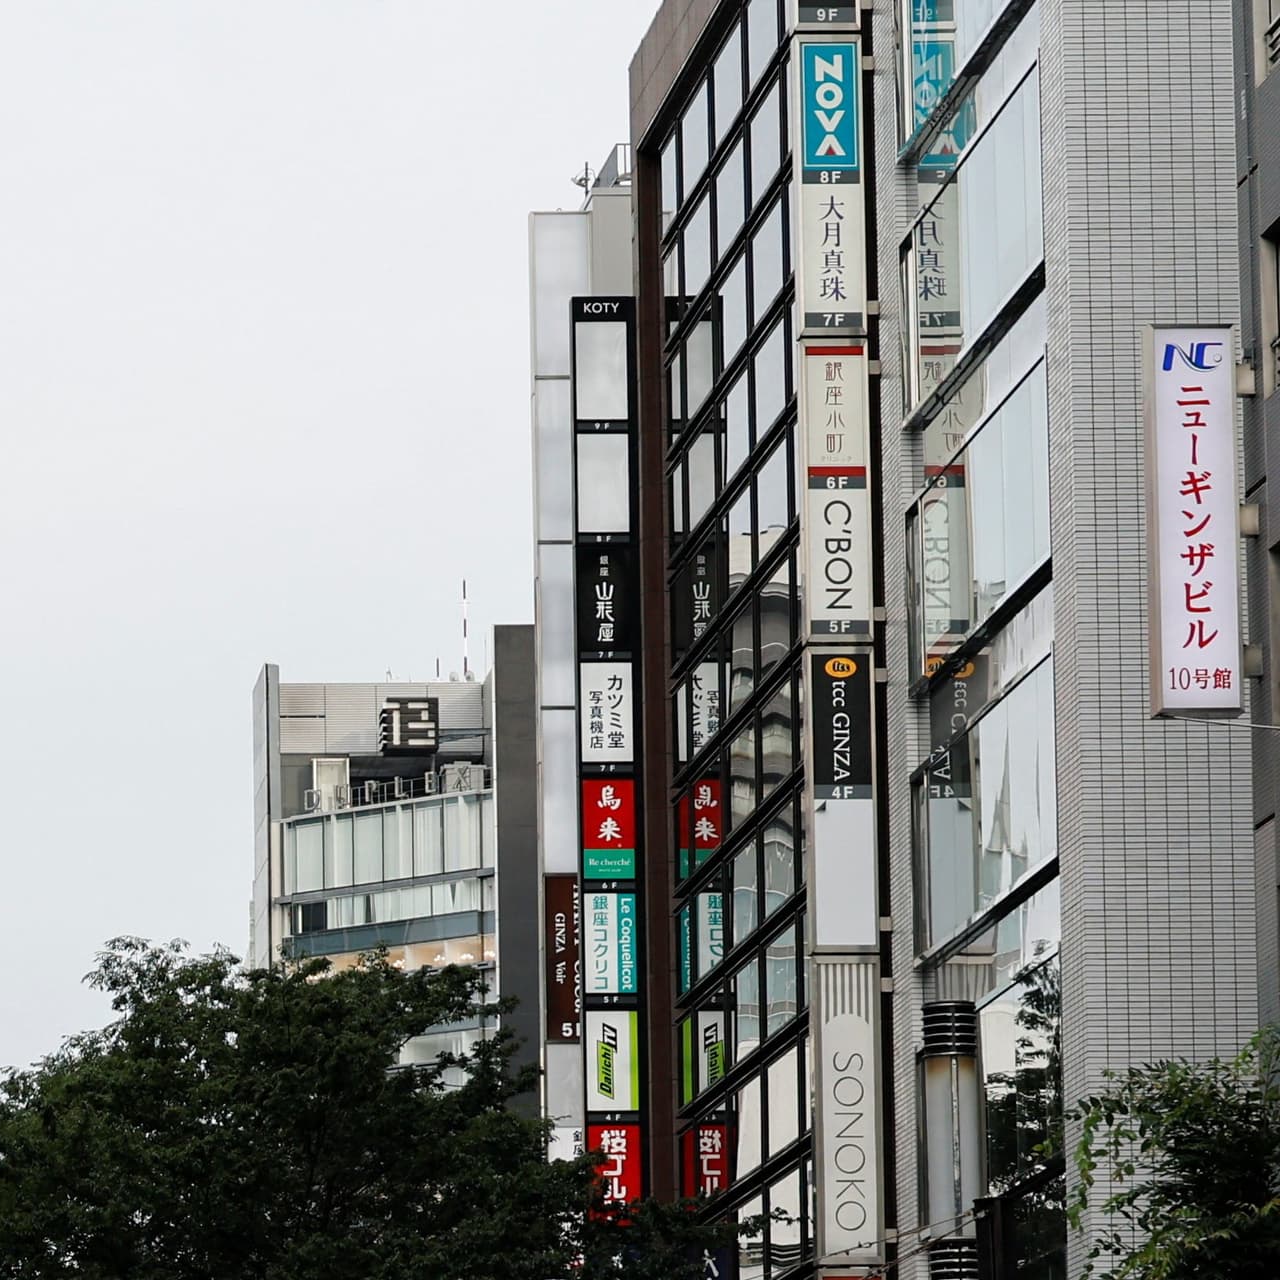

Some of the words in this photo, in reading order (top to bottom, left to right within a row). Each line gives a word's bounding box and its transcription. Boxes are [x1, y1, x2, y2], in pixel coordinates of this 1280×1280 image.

[817, 9, 838, 20] 9F
[814, 54, 846, 156] NOVA
[820, 172, 842, 183] 8F
[819, 195, 847, 302] 大月真珠
[583, 302, 620, 314] KOTY
[823, 315, 845, 325] 7F
[825, 361, 845, 453] 銀座小町
[826, 477, 848, 488] 6F
[1176, 385, 1218, 649] ニューギンザビル
[824, 501, 852, 610] C'BON
[595, 582, 615, 642] 山形屋
[829, 621, 851, 632] 5F
[832, 681, 845, 707] tcc
[1168, 667, 1232, 690] 10号館
[590, 690, 604, 749] 写真機店
[607, 674, 625, 749] カツミ堂
[832, 712, 851, 782] GINZA
[832, 786, 853, 798] 4F
[621, 897, 633, 913] Le
[555, 913, 566, 953] GINZA
[592, 895, 609, 990] 銀座コクリコ
[621, 915, 636, 991] Coquelicot
[555, 961, 567, 984] Voir
[833, 1051, 866, 1231] SONOKO
